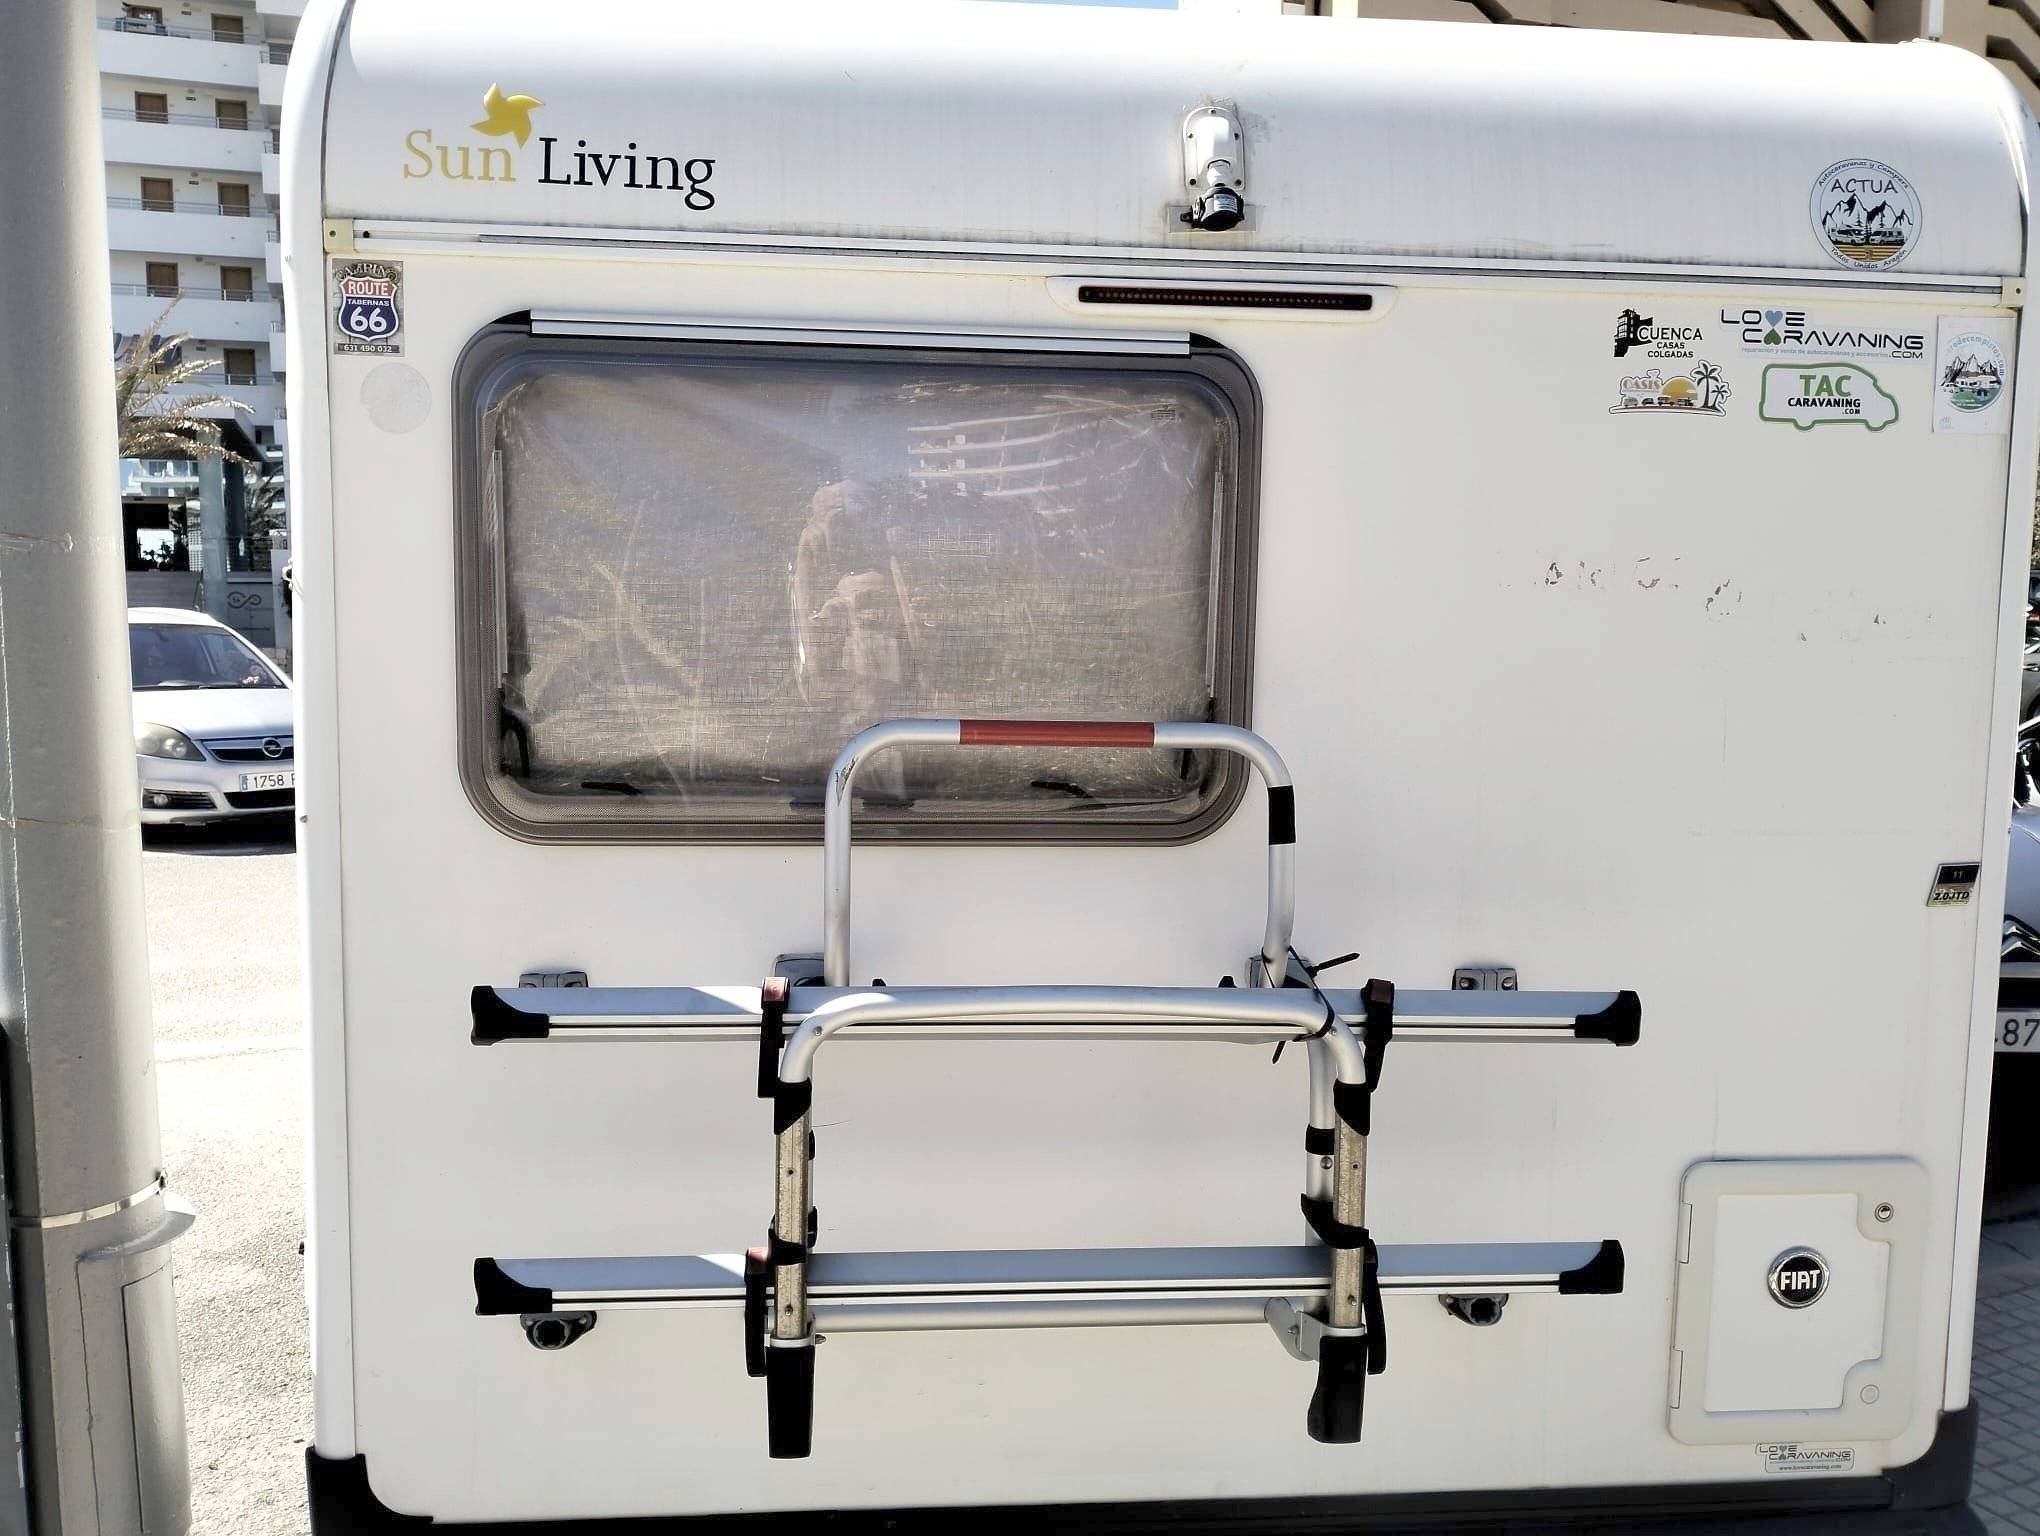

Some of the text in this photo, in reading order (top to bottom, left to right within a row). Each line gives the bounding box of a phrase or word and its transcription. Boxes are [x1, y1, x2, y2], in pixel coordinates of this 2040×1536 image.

[402, 129, 716, 211] Sun Living
[1831, 178, 1898, 194] ACTUA
[348, 281, 389, 296] ROUTE
[350, 306, 387, 332] 66
[1638, 326, 1703, 341] CUENCA
[1656, 341, 1685, 350] CASAS
[1647, 350, 1694, 359] COLGADAS
[1888, 350, 1924, 359] .COM
[1799, 374, 1852, 397] TAC
[1787, 397, 1861, 409] CARAVANING
[253, 774, 285, 789] 1758
[1780, 1269, 1820, 1291] FIAT
